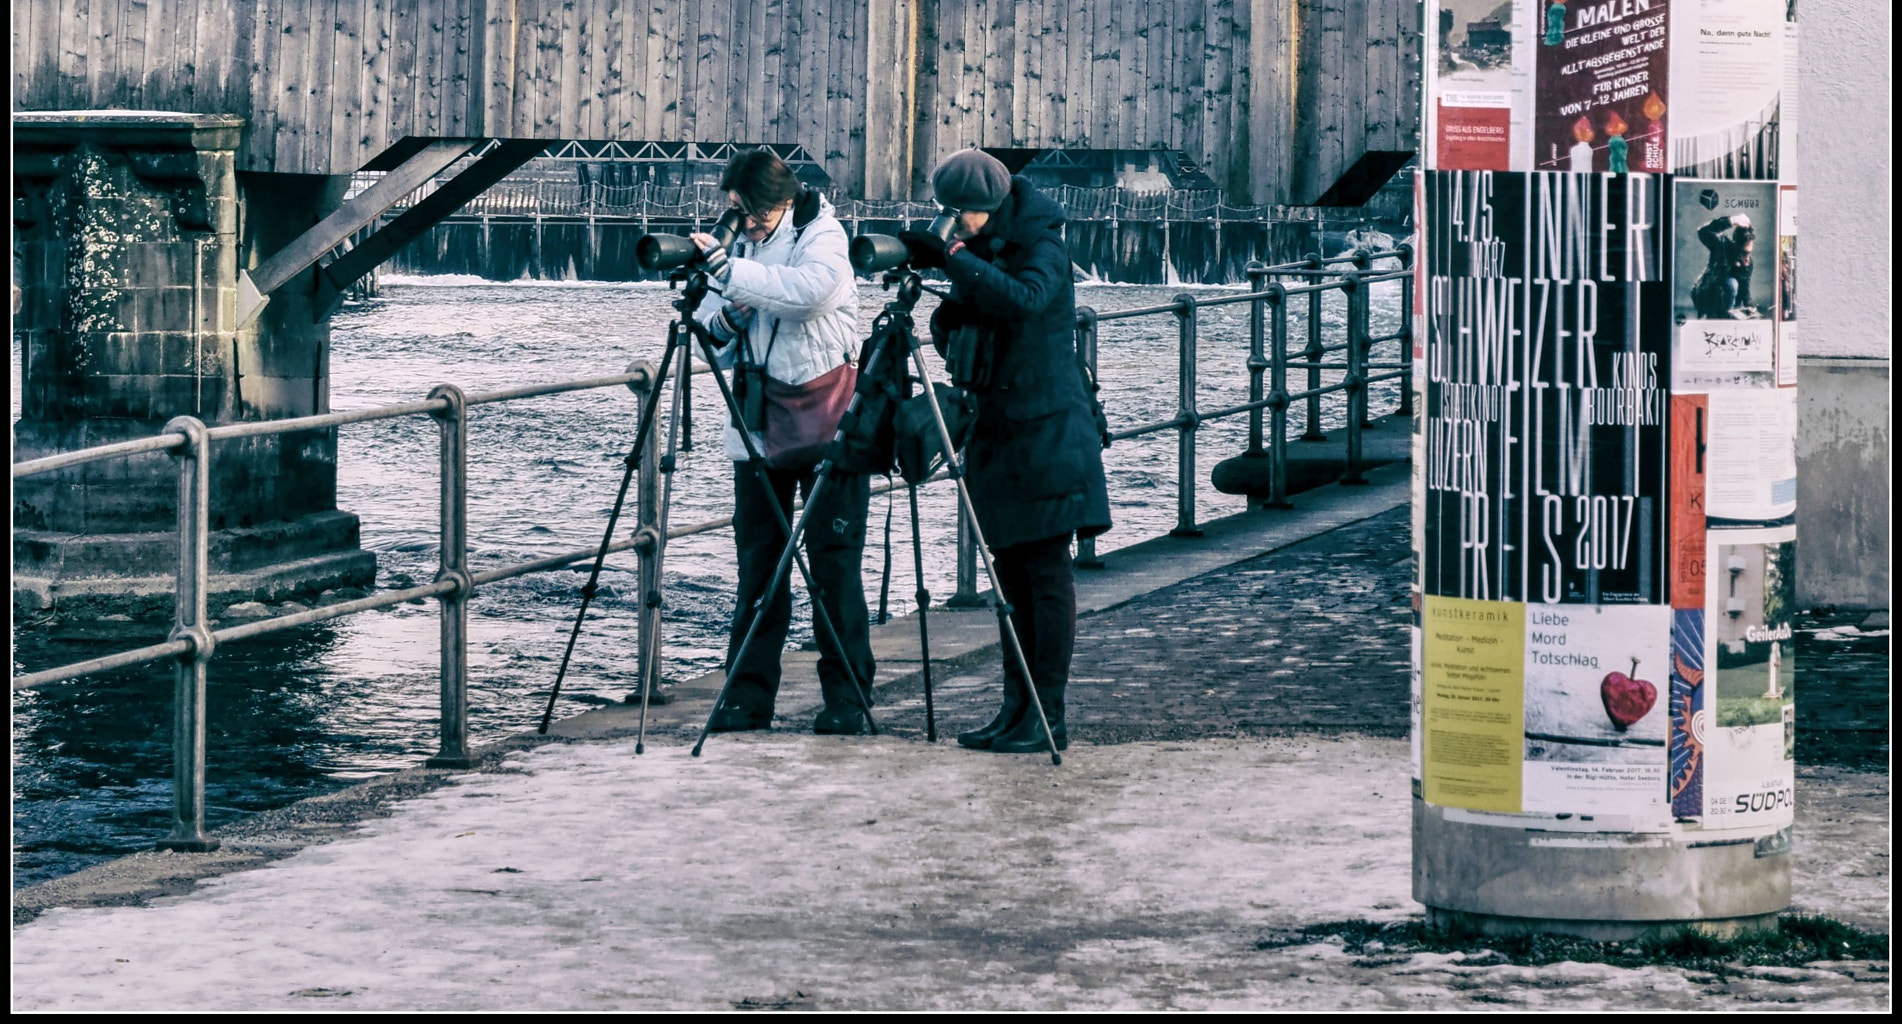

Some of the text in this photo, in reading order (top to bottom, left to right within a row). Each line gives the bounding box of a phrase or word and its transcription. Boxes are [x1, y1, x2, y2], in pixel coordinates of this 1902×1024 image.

[1565, 13, 1666, 49] DIE KLEINE UND GROSSE
[1621, 26, 1666, 46] WELT DER
[1716, 29, 1735, 37] dann
[1736, 31, 1752, 39] gute
[1614, 70, 1649, 89] KINDER
[1560, 100, 1582, 116] VON
[1612, 83, 1649, 102] JAHREN
[1472, 126, 1504, 135] ENGELBERG
[1652, 136, 1660, 169] SCHULE
[1525, 172, 1653, 282] INNER
[1432, 275, 1598, 389] SCHWEIZER
[1612, 352, 1658, 390] KINOS
[1588, 388, 1660, 426] BOURBAKI
[1429, 417, 1488, 492] LUZERN
[1576, 495, 1634, 570] 2017
[1432, 606, 1509, 622] kunstkeramik
[1532, 613, 1569, 627] Liebe
[1532, 632, 1567, 646] Mord
[1532, 651, 1599, 669] Totschlag
